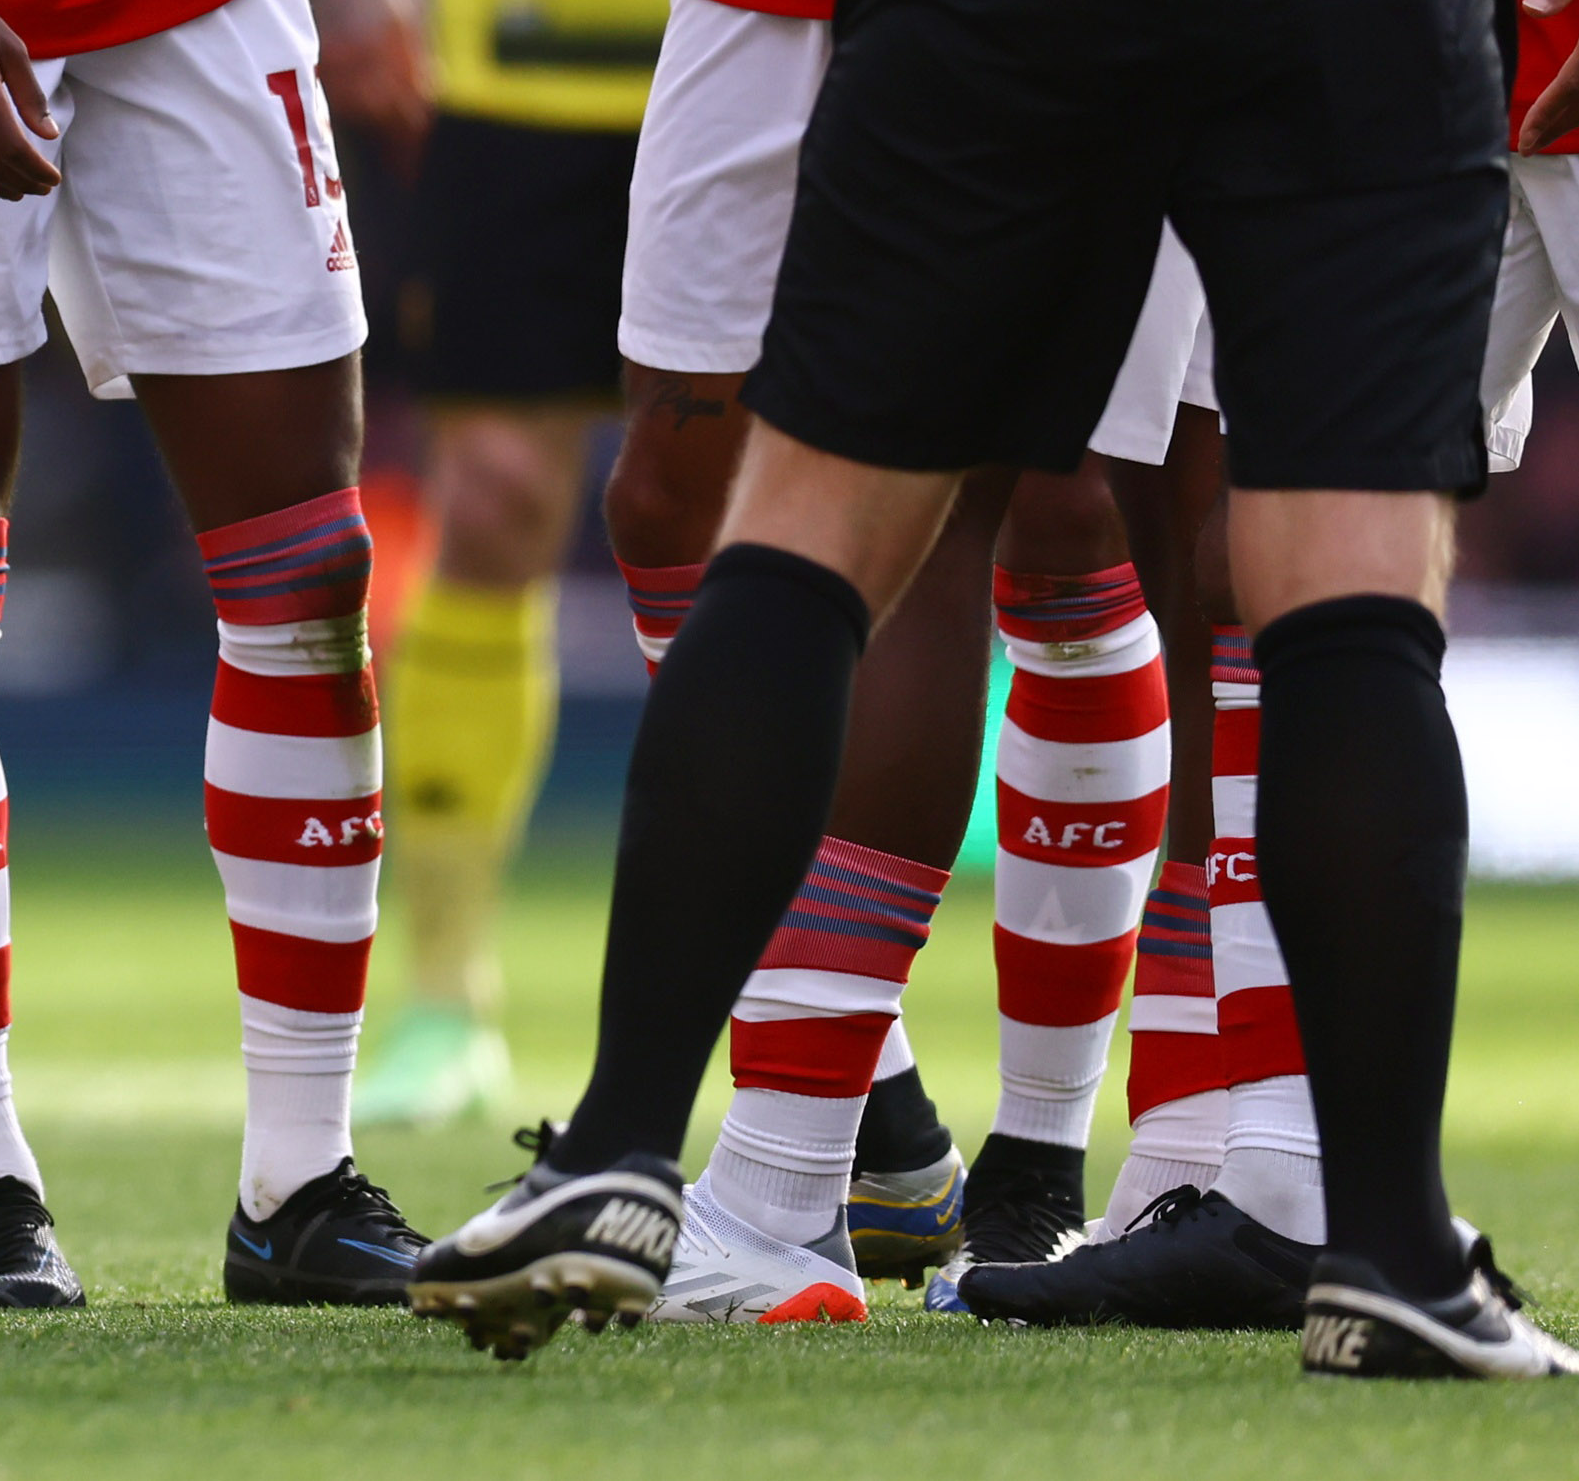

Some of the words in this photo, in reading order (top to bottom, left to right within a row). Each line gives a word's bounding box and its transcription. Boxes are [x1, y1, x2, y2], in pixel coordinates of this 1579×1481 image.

[266, 64, 342, 208] 1
[295, 810, 385, 848] AFC
[1023, 815, 1127, 850] AFC
[1205, 851, 1258, 889] FC
